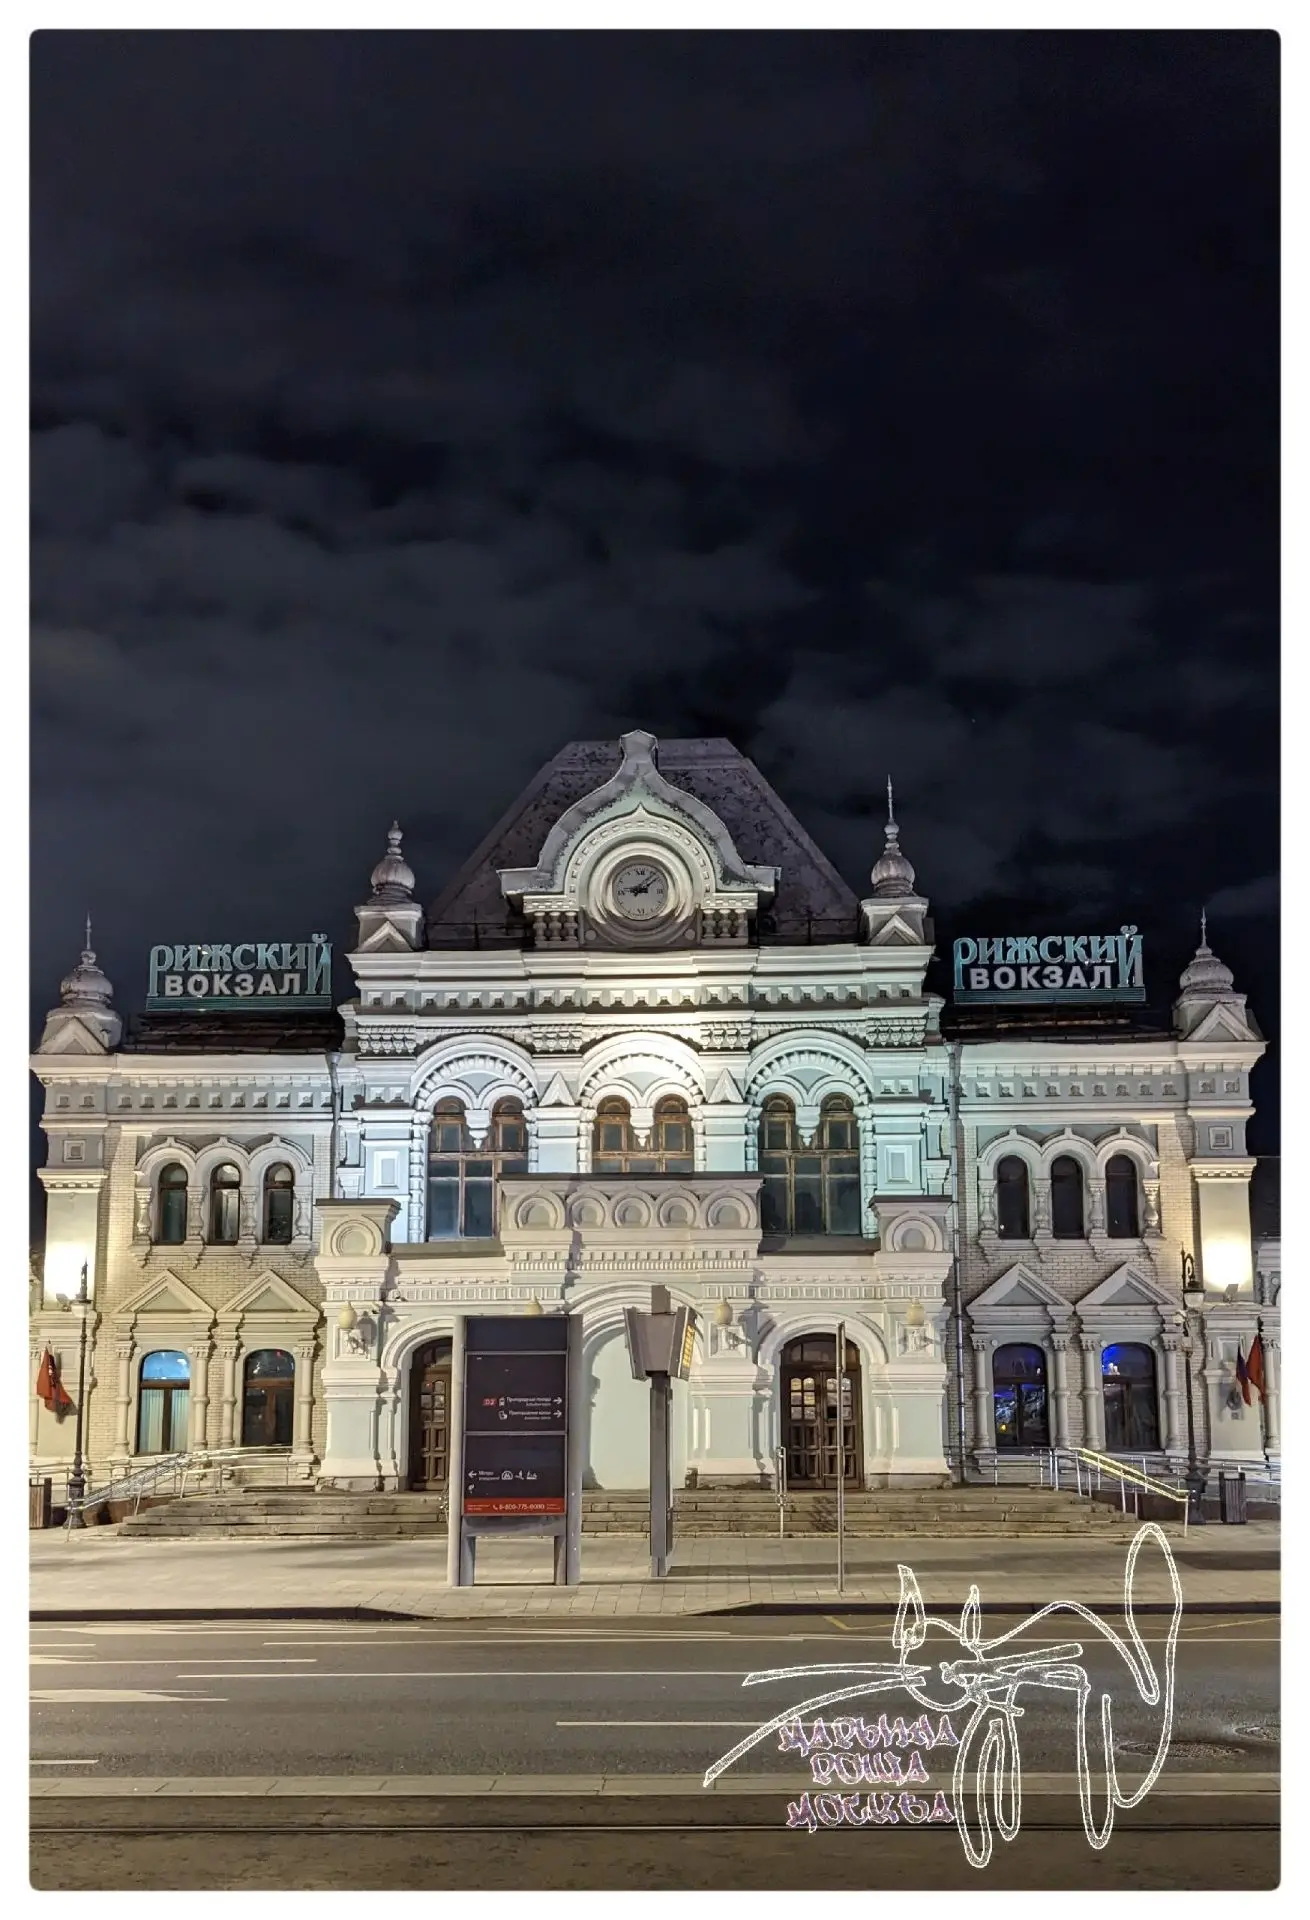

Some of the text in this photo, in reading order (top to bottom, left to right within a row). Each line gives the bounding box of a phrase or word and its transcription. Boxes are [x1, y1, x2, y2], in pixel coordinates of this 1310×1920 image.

[147, 933, 333, 996] РИЖСКИЙ
[953, 925, 1144, 989] РИЖСКИЙ
[970, 965, 1112, 989] ВОКЗАЛ
[165, 973, 301, 997] ВОКЗАЛ
